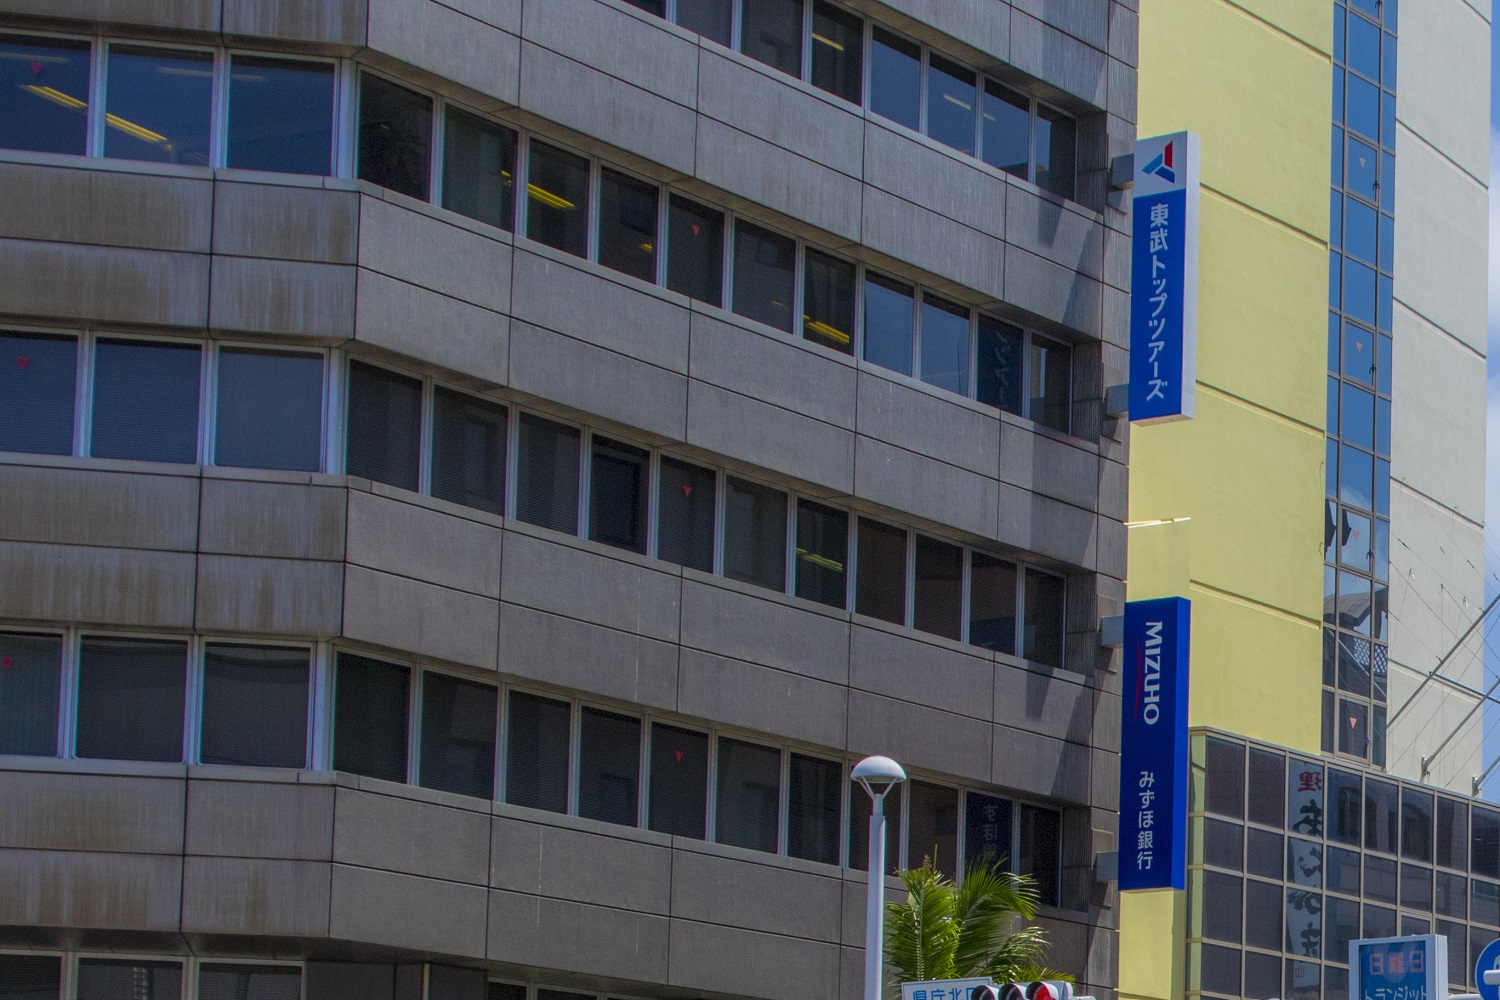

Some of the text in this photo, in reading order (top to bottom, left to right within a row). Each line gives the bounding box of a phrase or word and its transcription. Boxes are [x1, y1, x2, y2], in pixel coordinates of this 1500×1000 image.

[1146, 203, 1169, 402] 東武トップツアーズ
[1143, 620, 1163, 726] MIZUHO
[1137, 771, 1155, 870] みずほ銀行
[1369, 950, 1425, 977] 日曜日
